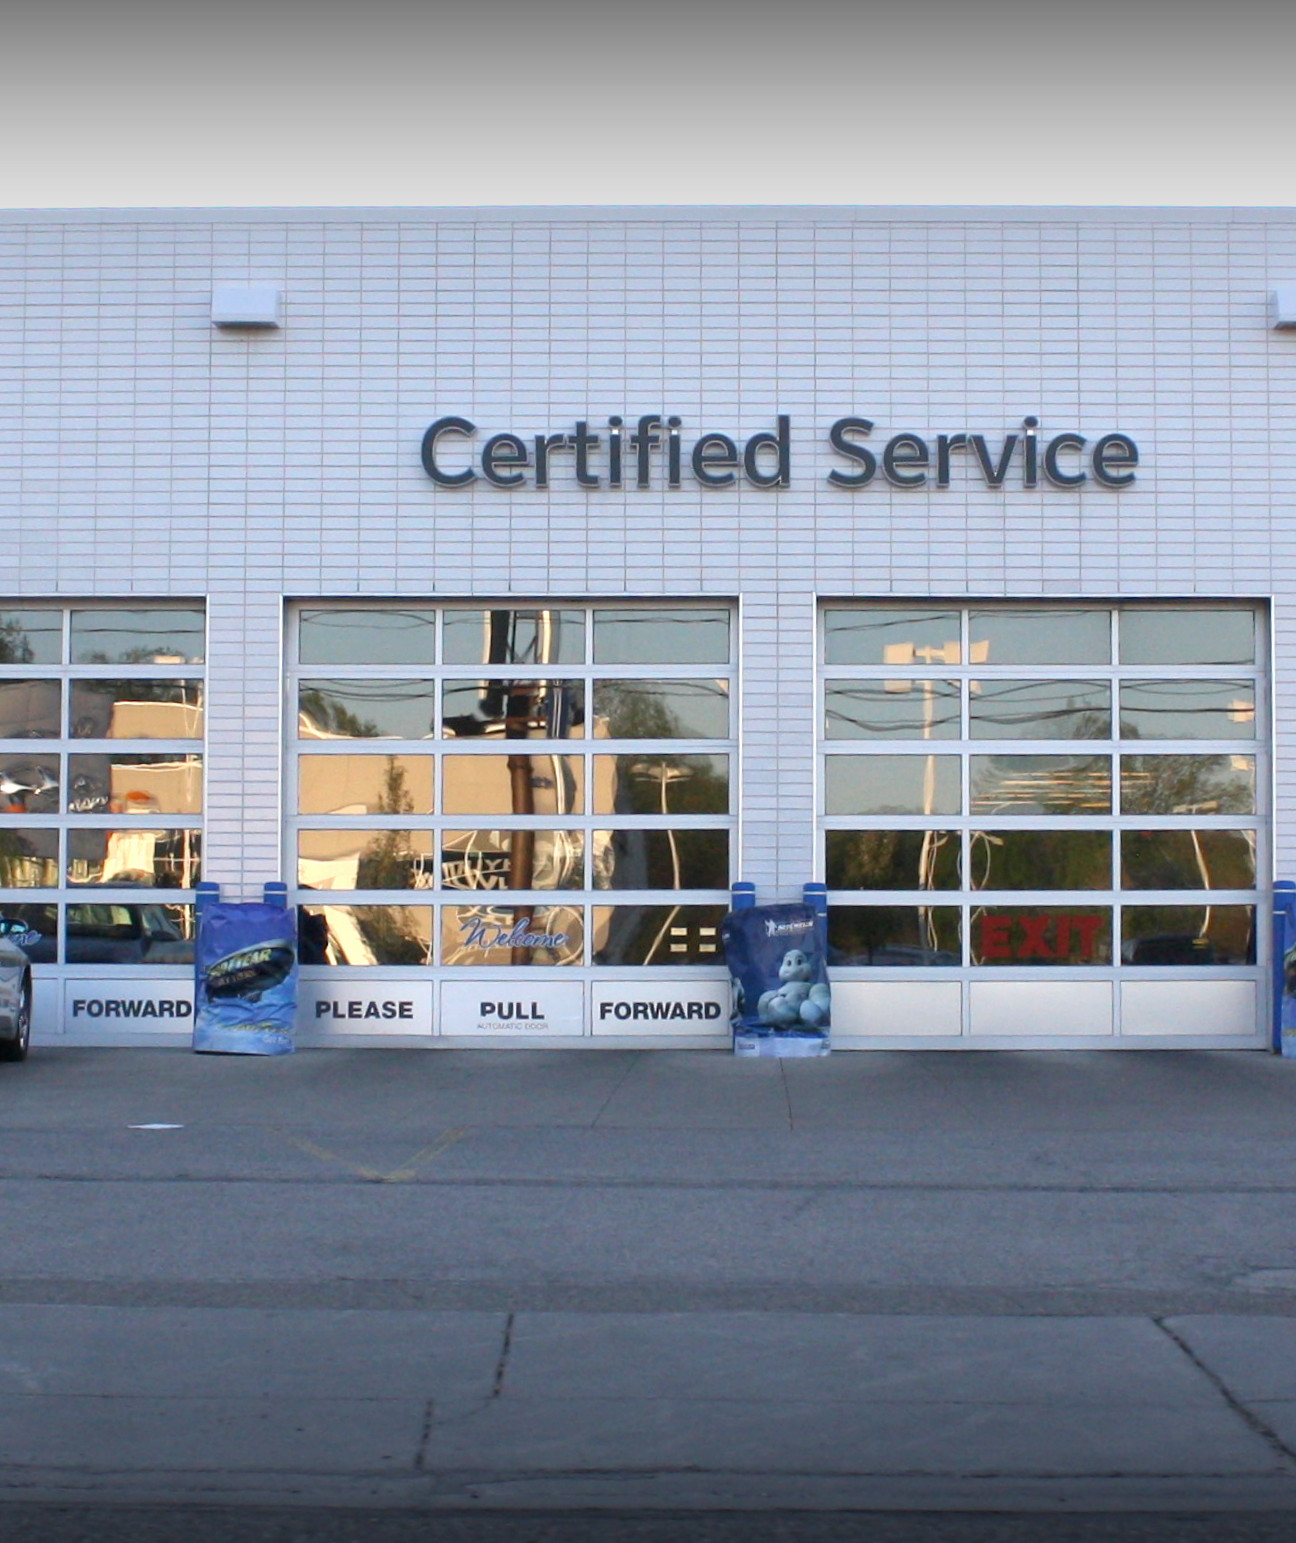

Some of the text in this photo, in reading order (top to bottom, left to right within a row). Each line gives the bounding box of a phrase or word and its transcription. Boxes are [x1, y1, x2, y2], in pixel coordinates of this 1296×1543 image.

[420, 414, 1140, 490] Certified Service
[460, 916, 566, 949] Welcome
[981, 914, 1103, 958] EXIT
[72, 999, 193, 1018] FORWARD
[315, 1000, 413, 1019] PLEASE
[480, 1001, 545, 1020] PULL
[599, 1002, 721, 1020] FORWARD
